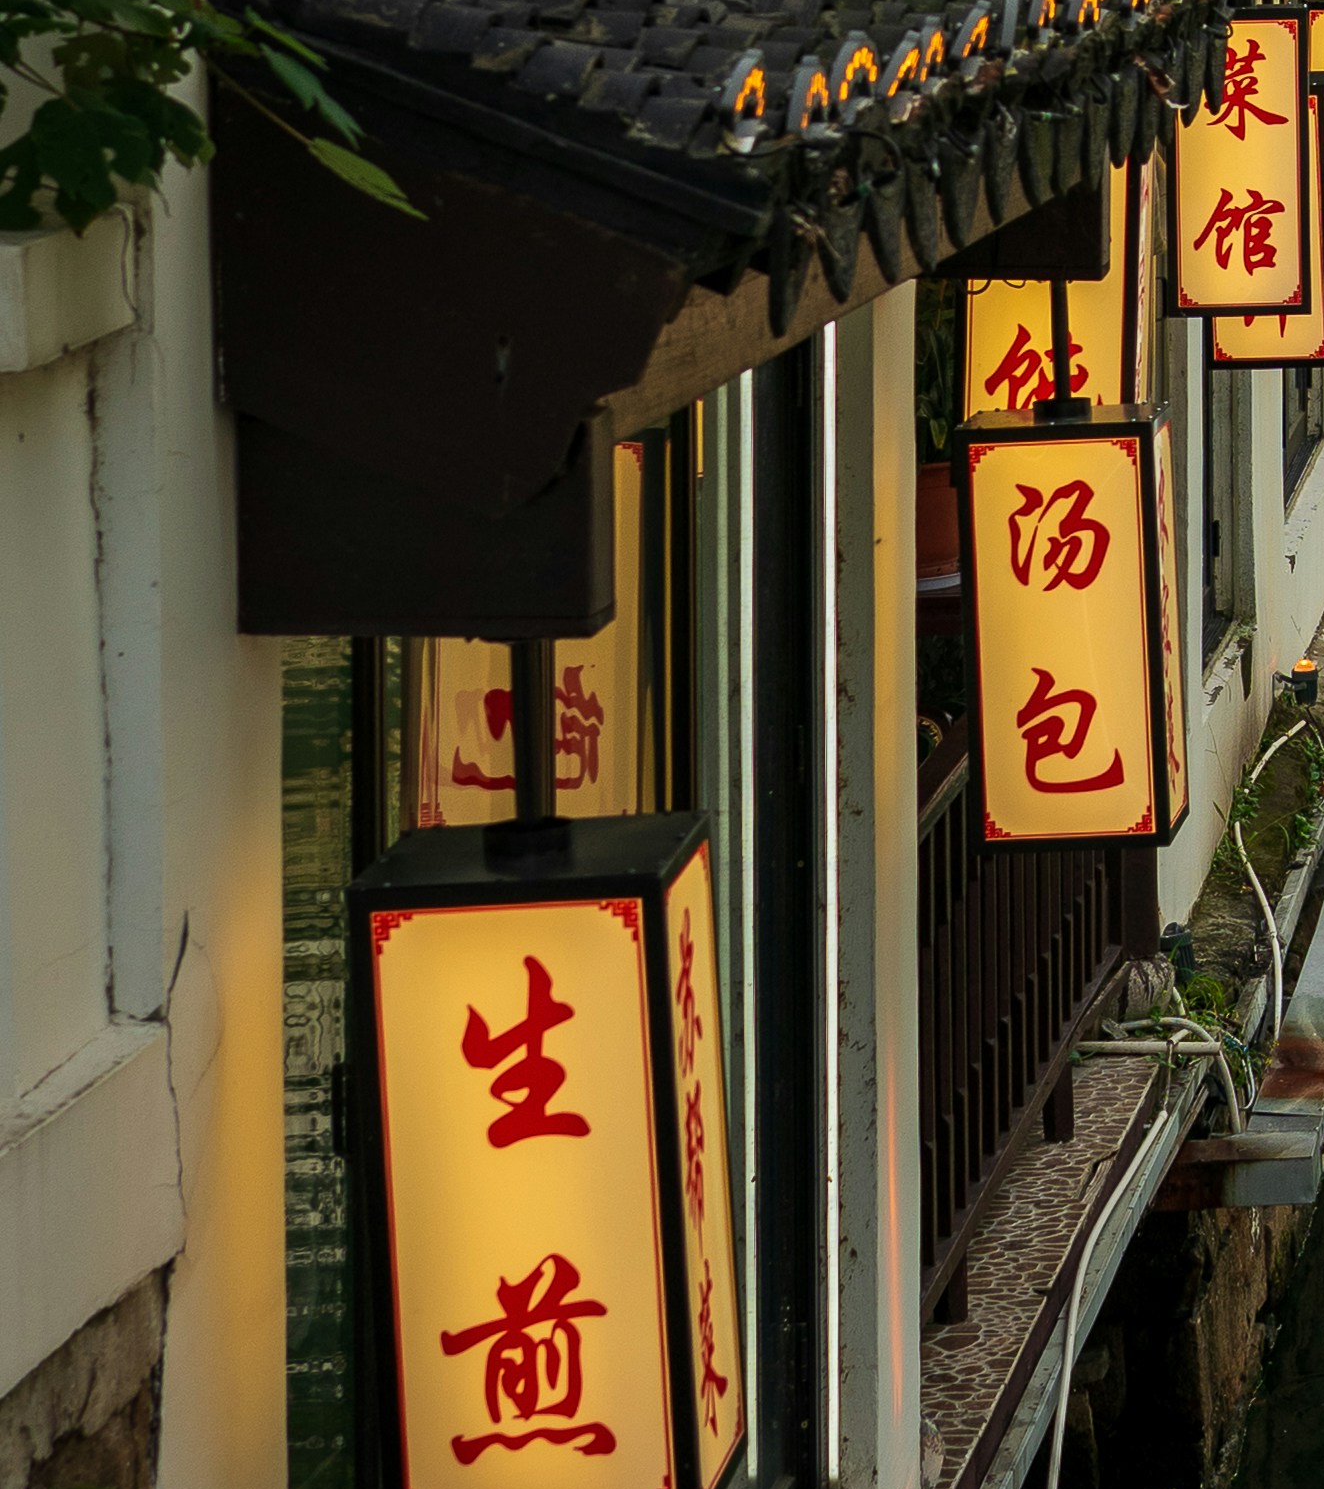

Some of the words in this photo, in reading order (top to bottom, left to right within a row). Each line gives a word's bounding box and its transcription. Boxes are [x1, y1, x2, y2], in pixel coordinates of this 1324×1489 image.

[1193, 38, 1289, 277] 菜馆
[1007, 479, 1125, 795] 汤包
[440, 954, 617, 1465] 生煎
